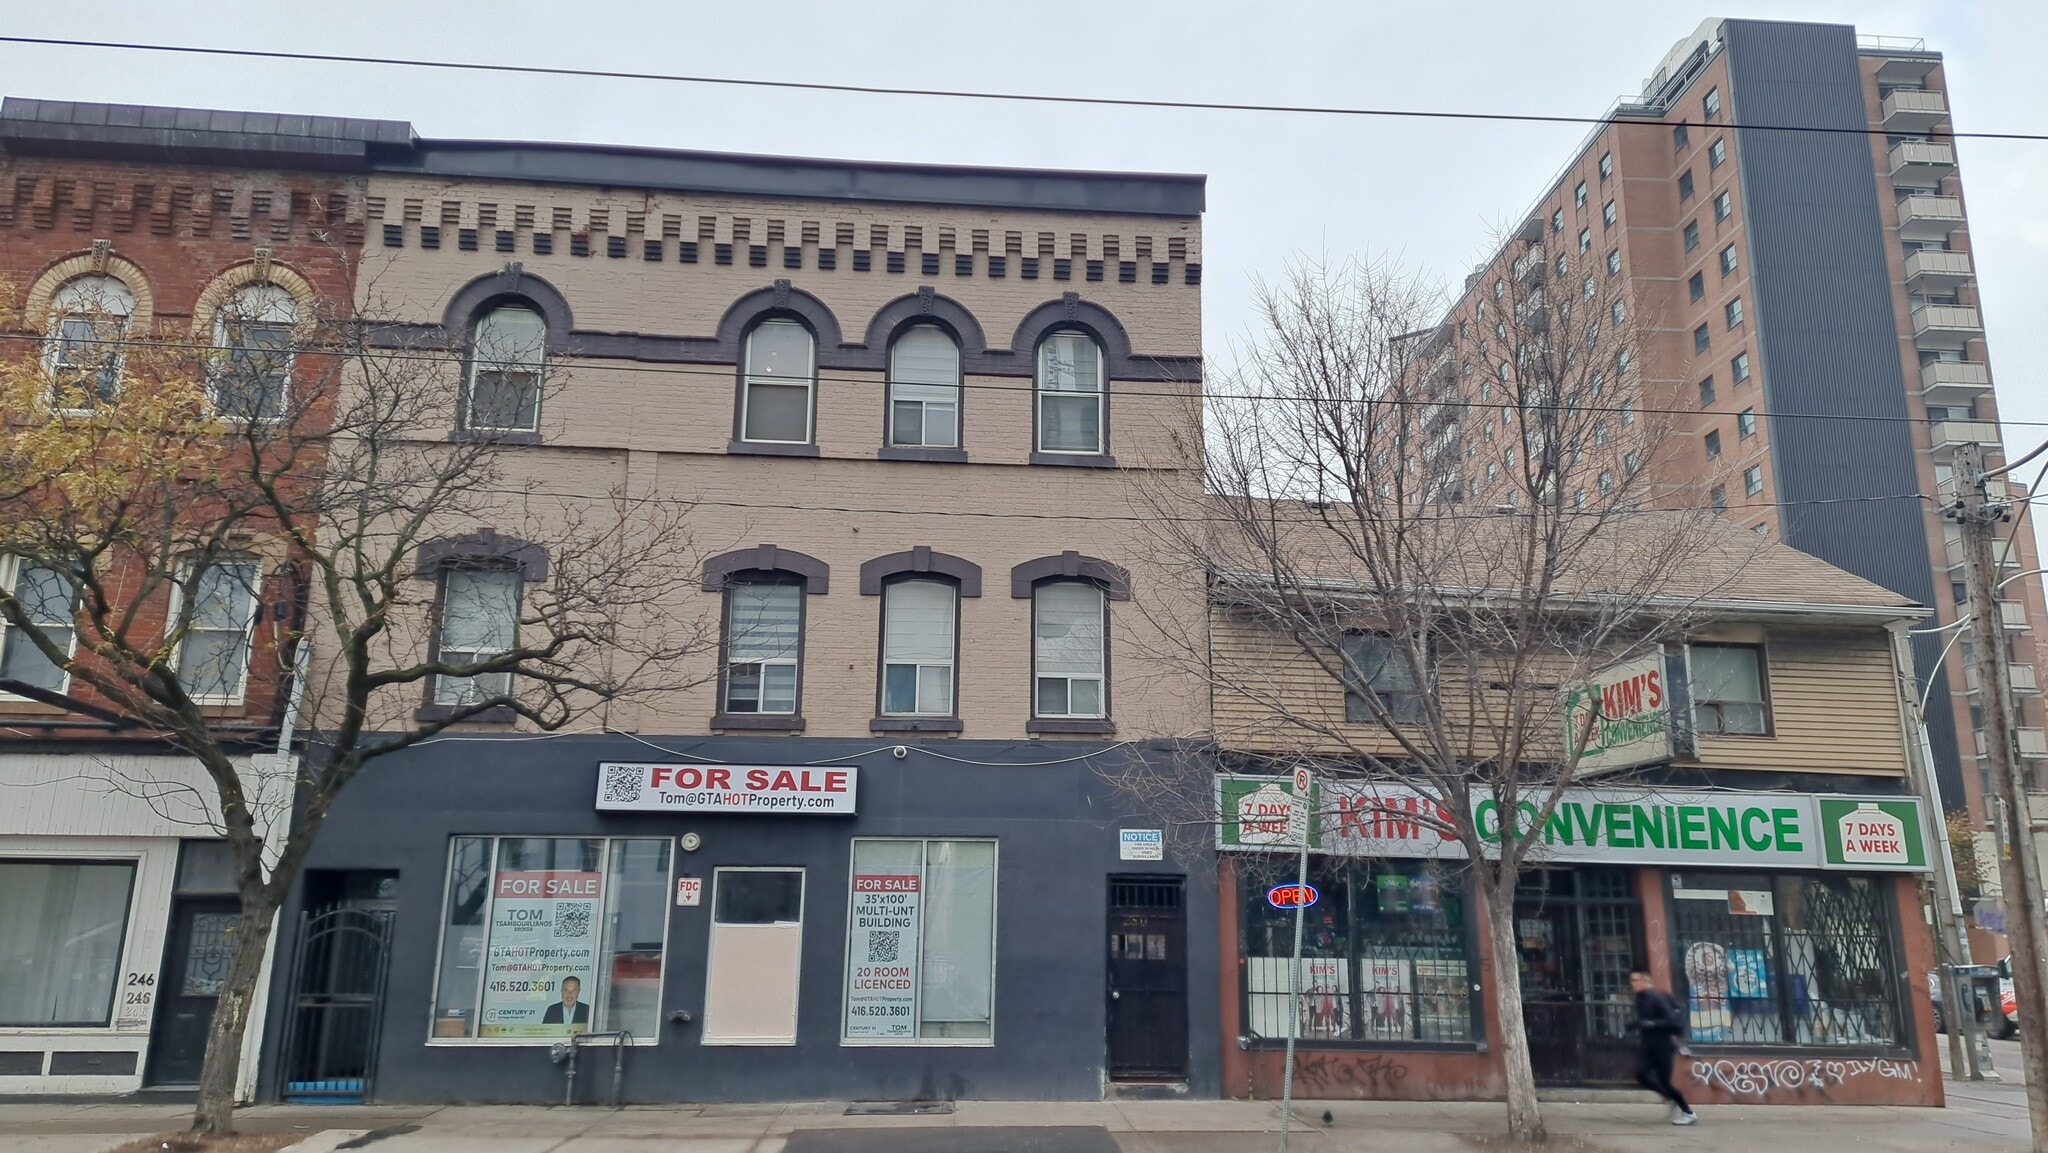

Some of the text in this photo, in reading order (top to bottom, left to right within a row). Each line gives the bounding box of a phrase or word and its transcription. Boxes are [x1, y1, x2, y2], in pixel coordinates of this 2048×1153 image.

[1603, 669, 1662, 719] KIM'S
[650, 767, 848, 793] FOR SALE
[658, 791, 835, 809] Tom@GTAHOTProperty.com
[1244, 803, 1253, 815] 7
[1258, 820, 1288, 833] WEE
[1339, 796, 1459, 841] KIM'S
[1475, 799, 1803, 852] CONVENIENCE
[1845, 823, 1895, 836] 7 DAYS
[1123, 833, 1159, 841] NOTICE
[1846, 839, 1900, 853] A WEEK
[500, 879, 597, 895] FOR SALE
[679, 881, 699, 891] FDC
[856, 880, 917, 890] FOR SALE
[864, 894, 908, 904] 35'x100'
[1270, 889, 1314, 905] OPEN
[507, 909, 543, 920] TOM
[856, 906, 915, 916] MULTI-UNT
[858, 918, 911, 928] BUILDING
[493, 947, 590, 960] GTAHOTProperty.com
[857, 967, 909, 977] 20 ROOM
[1309, 966, 1336, 975] KIM'S
[1372, 966, 1398, 975] KIM'S
[127, 973, 155, 986] 246
[854, 979, 911, 989] LICENCED
[489, 981, 555, 993] 416.520.3601
[851, 1006, 910, 1016] 416.520.3601
